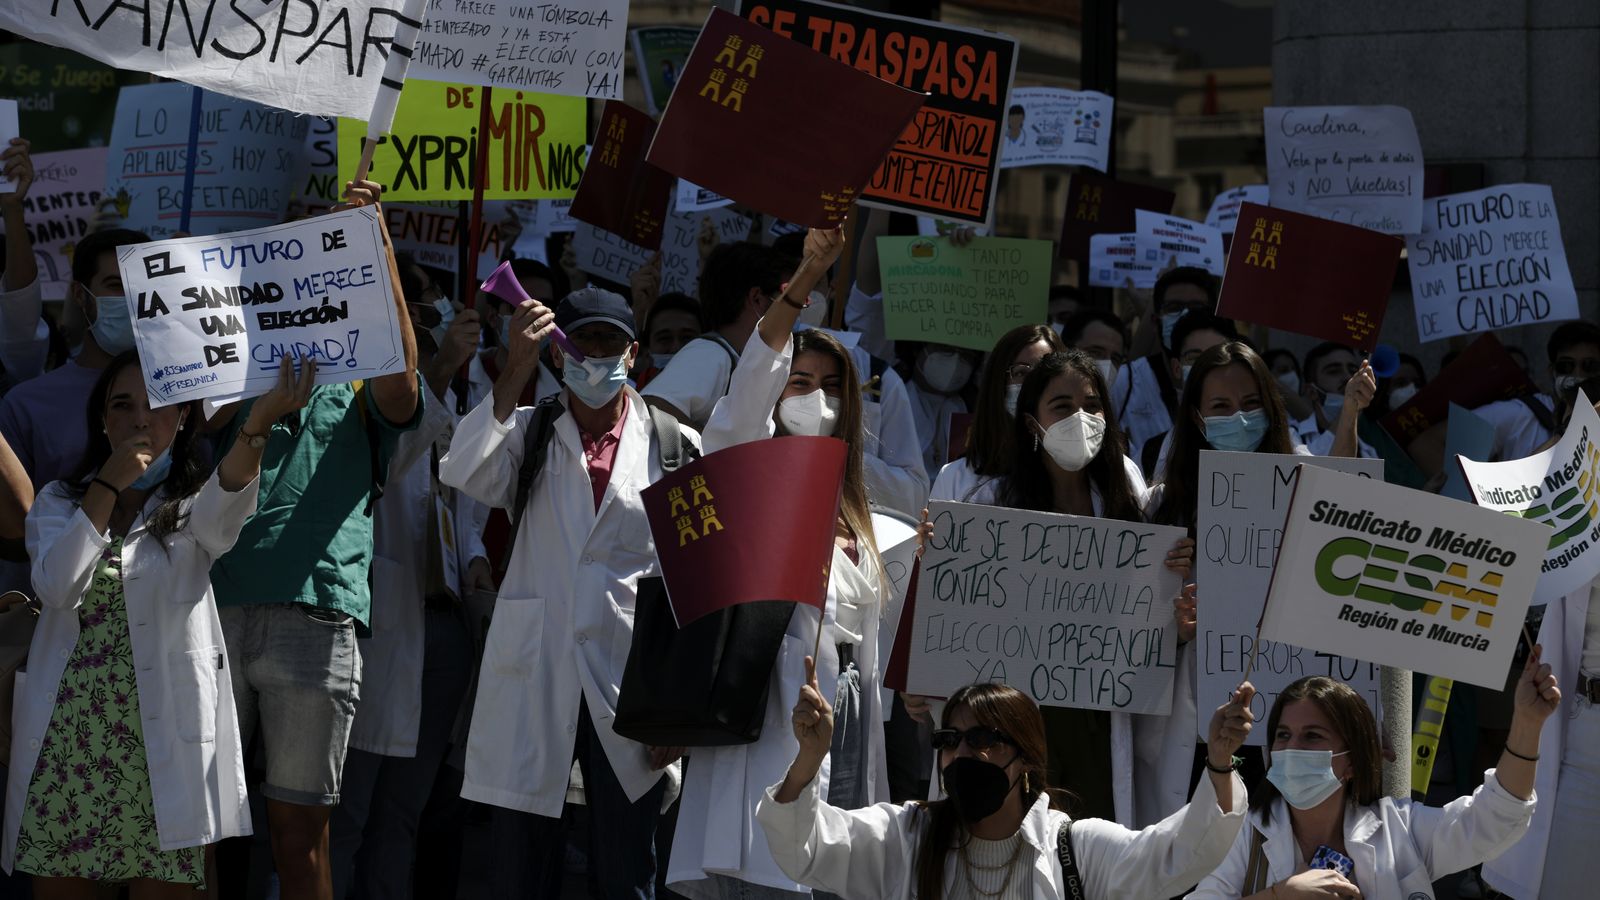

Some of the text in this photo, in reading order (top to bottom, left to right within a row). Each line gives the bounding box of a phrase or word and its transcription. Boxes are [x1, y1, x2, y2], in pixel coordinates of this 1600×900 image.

[455, 0, 496, 16] PARECE
[510, 6, 534, 20] UNA
[434, 20, 491, 38] EMPEZADO
[502, 26, 509, 40] Y
[515, 28, 531, 41] YA
[585, 50, 623, 70] CON
[807, 15, 1000, 106] TRASPASA
[50, 64, 116, 94] Juega
[585, 70, 619, 98] YA!
[446, 86, 474, 109] DE
[135, 107, 168, 139] LO
[239, 108, 286, 138] AYER
[897, 110, 989, 158] SPAÑOL
[232, 146, 267, 175] HOY
[1306, 175, 1332, 196] NO
[1437, 192, 1553, 230] FUTURO DE LA
[143, 229, 347, 280] EL FUTURO DE
[1503, 230, 1550, 252] MERECE
[969, 247, 1023, 267] TANTO
[137, 264, 376, 320] LA SANIDAD MERECE
[888, 281, 1016, 300] ESTUDIANDO PARA
[970, 268, 1030, 286] TIEMPO
[1419, 279, 1447, 298] UNA
[199, 297, 349, 337] UNA ELECCIÓN
[890, 299, 937, 314] HACER
[943, 299, 956, 315] LA
[1004, 304, 1024, 320] DE
[1421, 312, 1443, 337] DE
[920, 318, 994, 338] LA COMPRA
[202, 342, 240, 368] DE
[1476, 424, 1589, 506] Sindicato Médico
[1210, 471, 1249, 510] DE
[928, 510, 1157, 571] QUE SE DEJEN DE
[1308, 499, 1518, 569] Sindicato Médico
[1019, 572, 1038, 613] Y
[1041, 576, 1118, 615] HAGAN
[1120, 584, 1154, 622] LA
[1314, 536, 1505, 630] CESM
[1336, 603, 1491, 653] Región de Murcia
[1047, 622, 1176, 669] PRESENCIAL
[1030, 663, 1138, 708] OSTIAS
